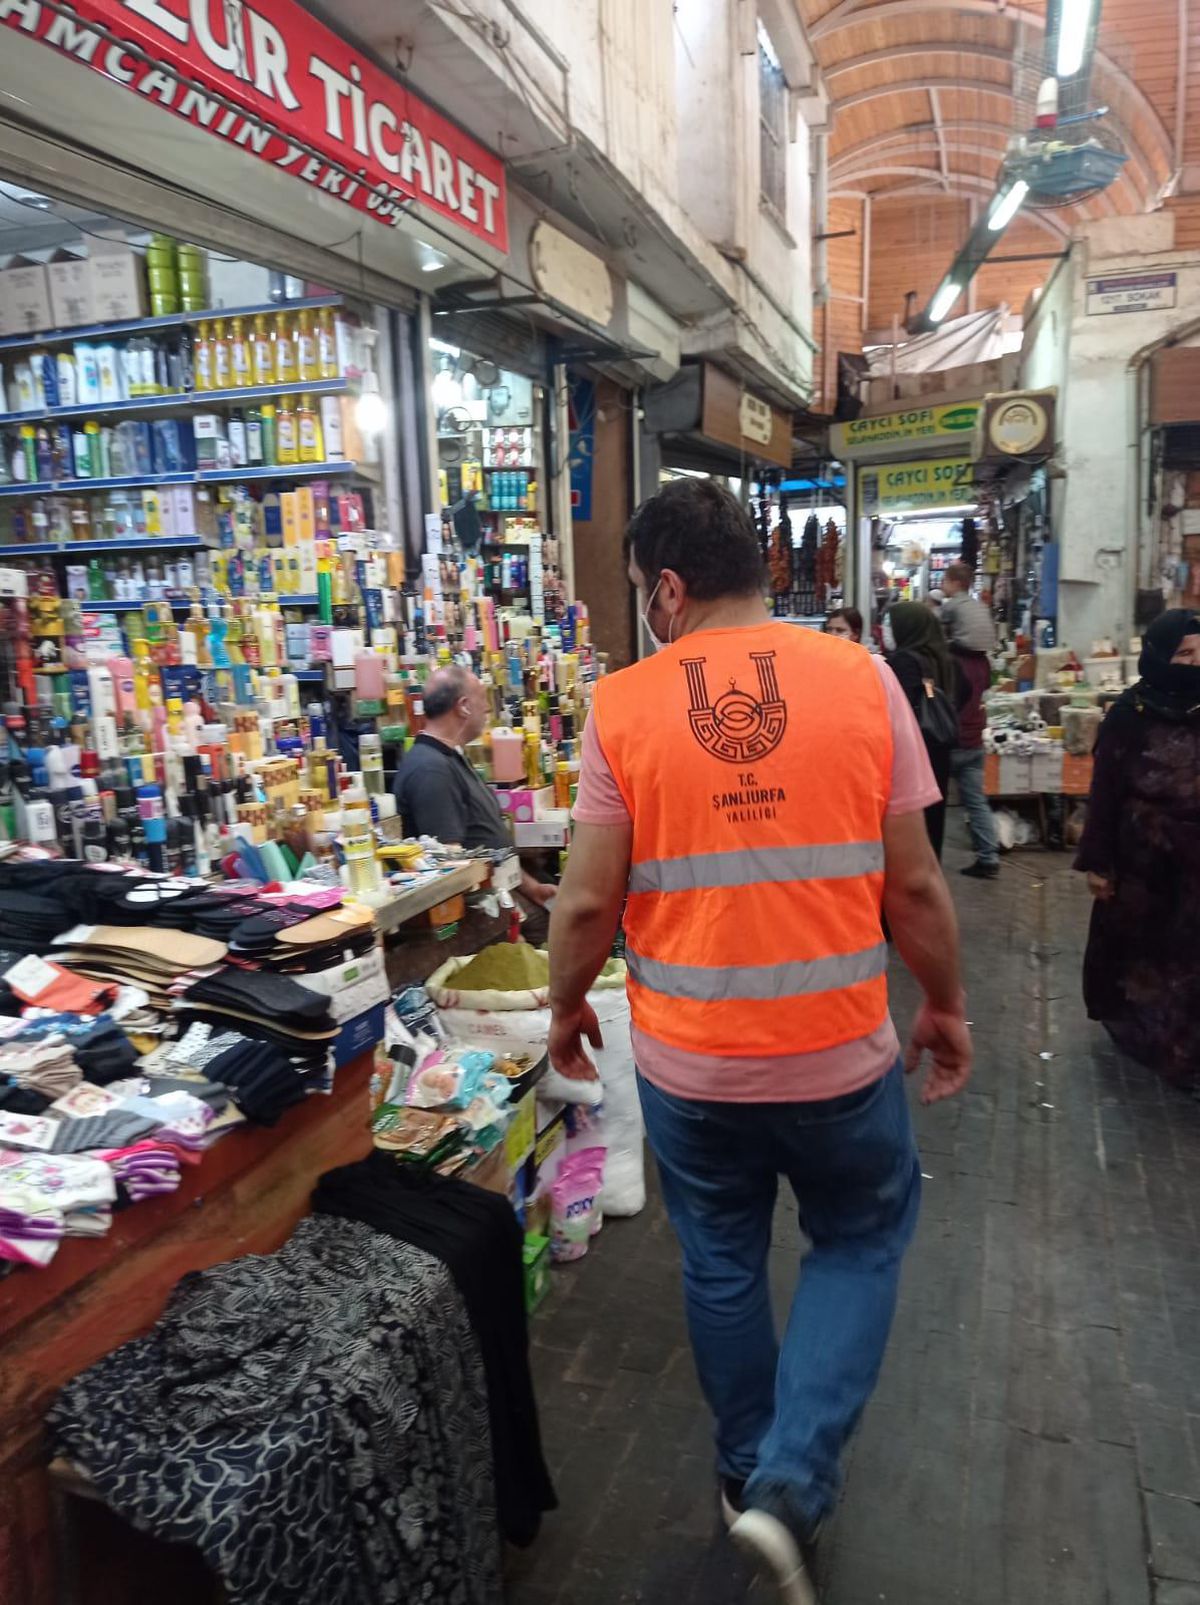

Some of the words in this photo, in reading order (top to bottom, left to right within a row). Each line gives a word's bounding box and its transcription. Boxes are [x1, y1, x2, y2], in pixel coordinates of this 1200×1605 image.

[308, 55, 500, 234] TİCARET
[737, 772, 758, 787] T.C.
[712, 787, 786, 811] ŞANLIURFA
